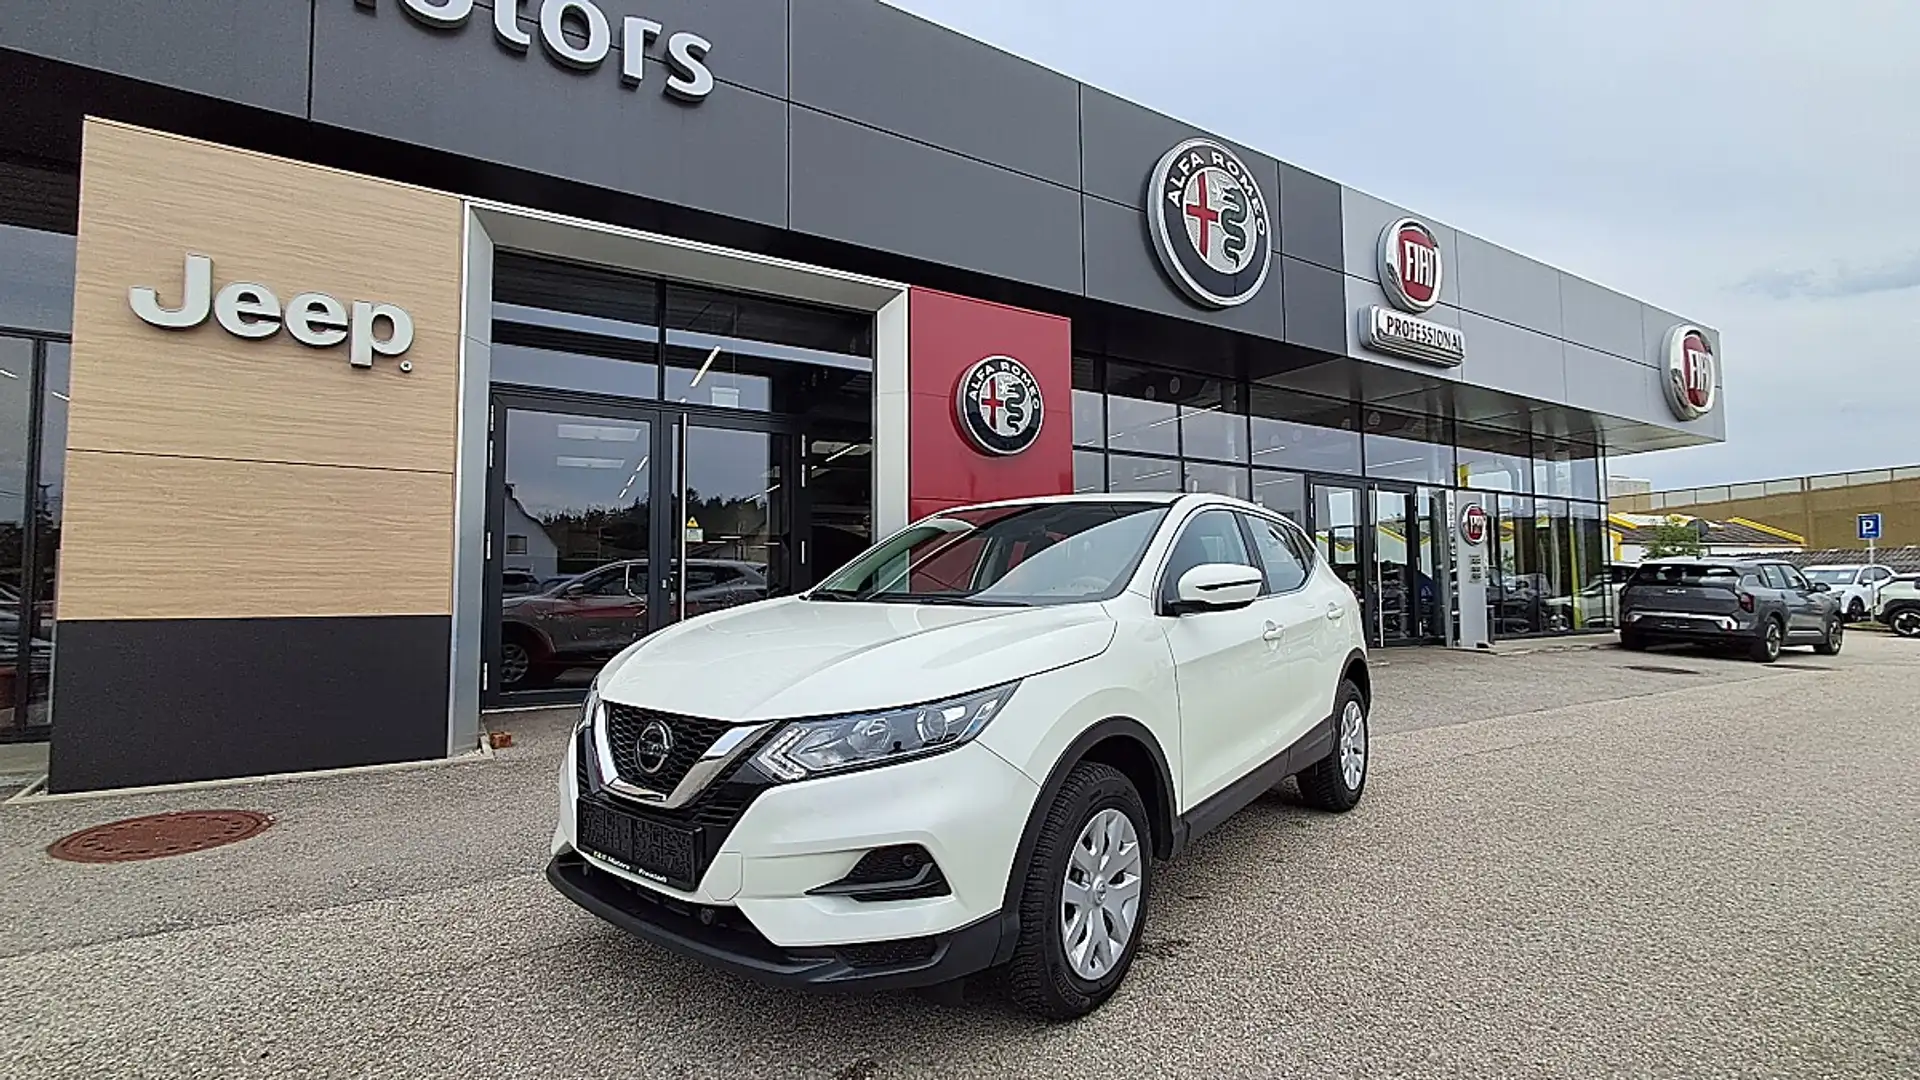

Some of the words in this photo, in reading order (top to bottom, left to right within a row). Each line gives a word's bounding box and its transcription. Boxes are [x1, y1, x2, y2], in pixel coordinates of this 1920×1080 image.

[1167, 152, 1205, 208] ALFA
[1210, 151, 1265, 236] ROMEO
[1404, 240, 1434, 288] FIAT
[128, 251, 415, 369] Jeep
[968, 364, 995, 401] ALFA
[1000, 361, 1040, 410] ROMEO
[1862, 519, 1875, 535] P
